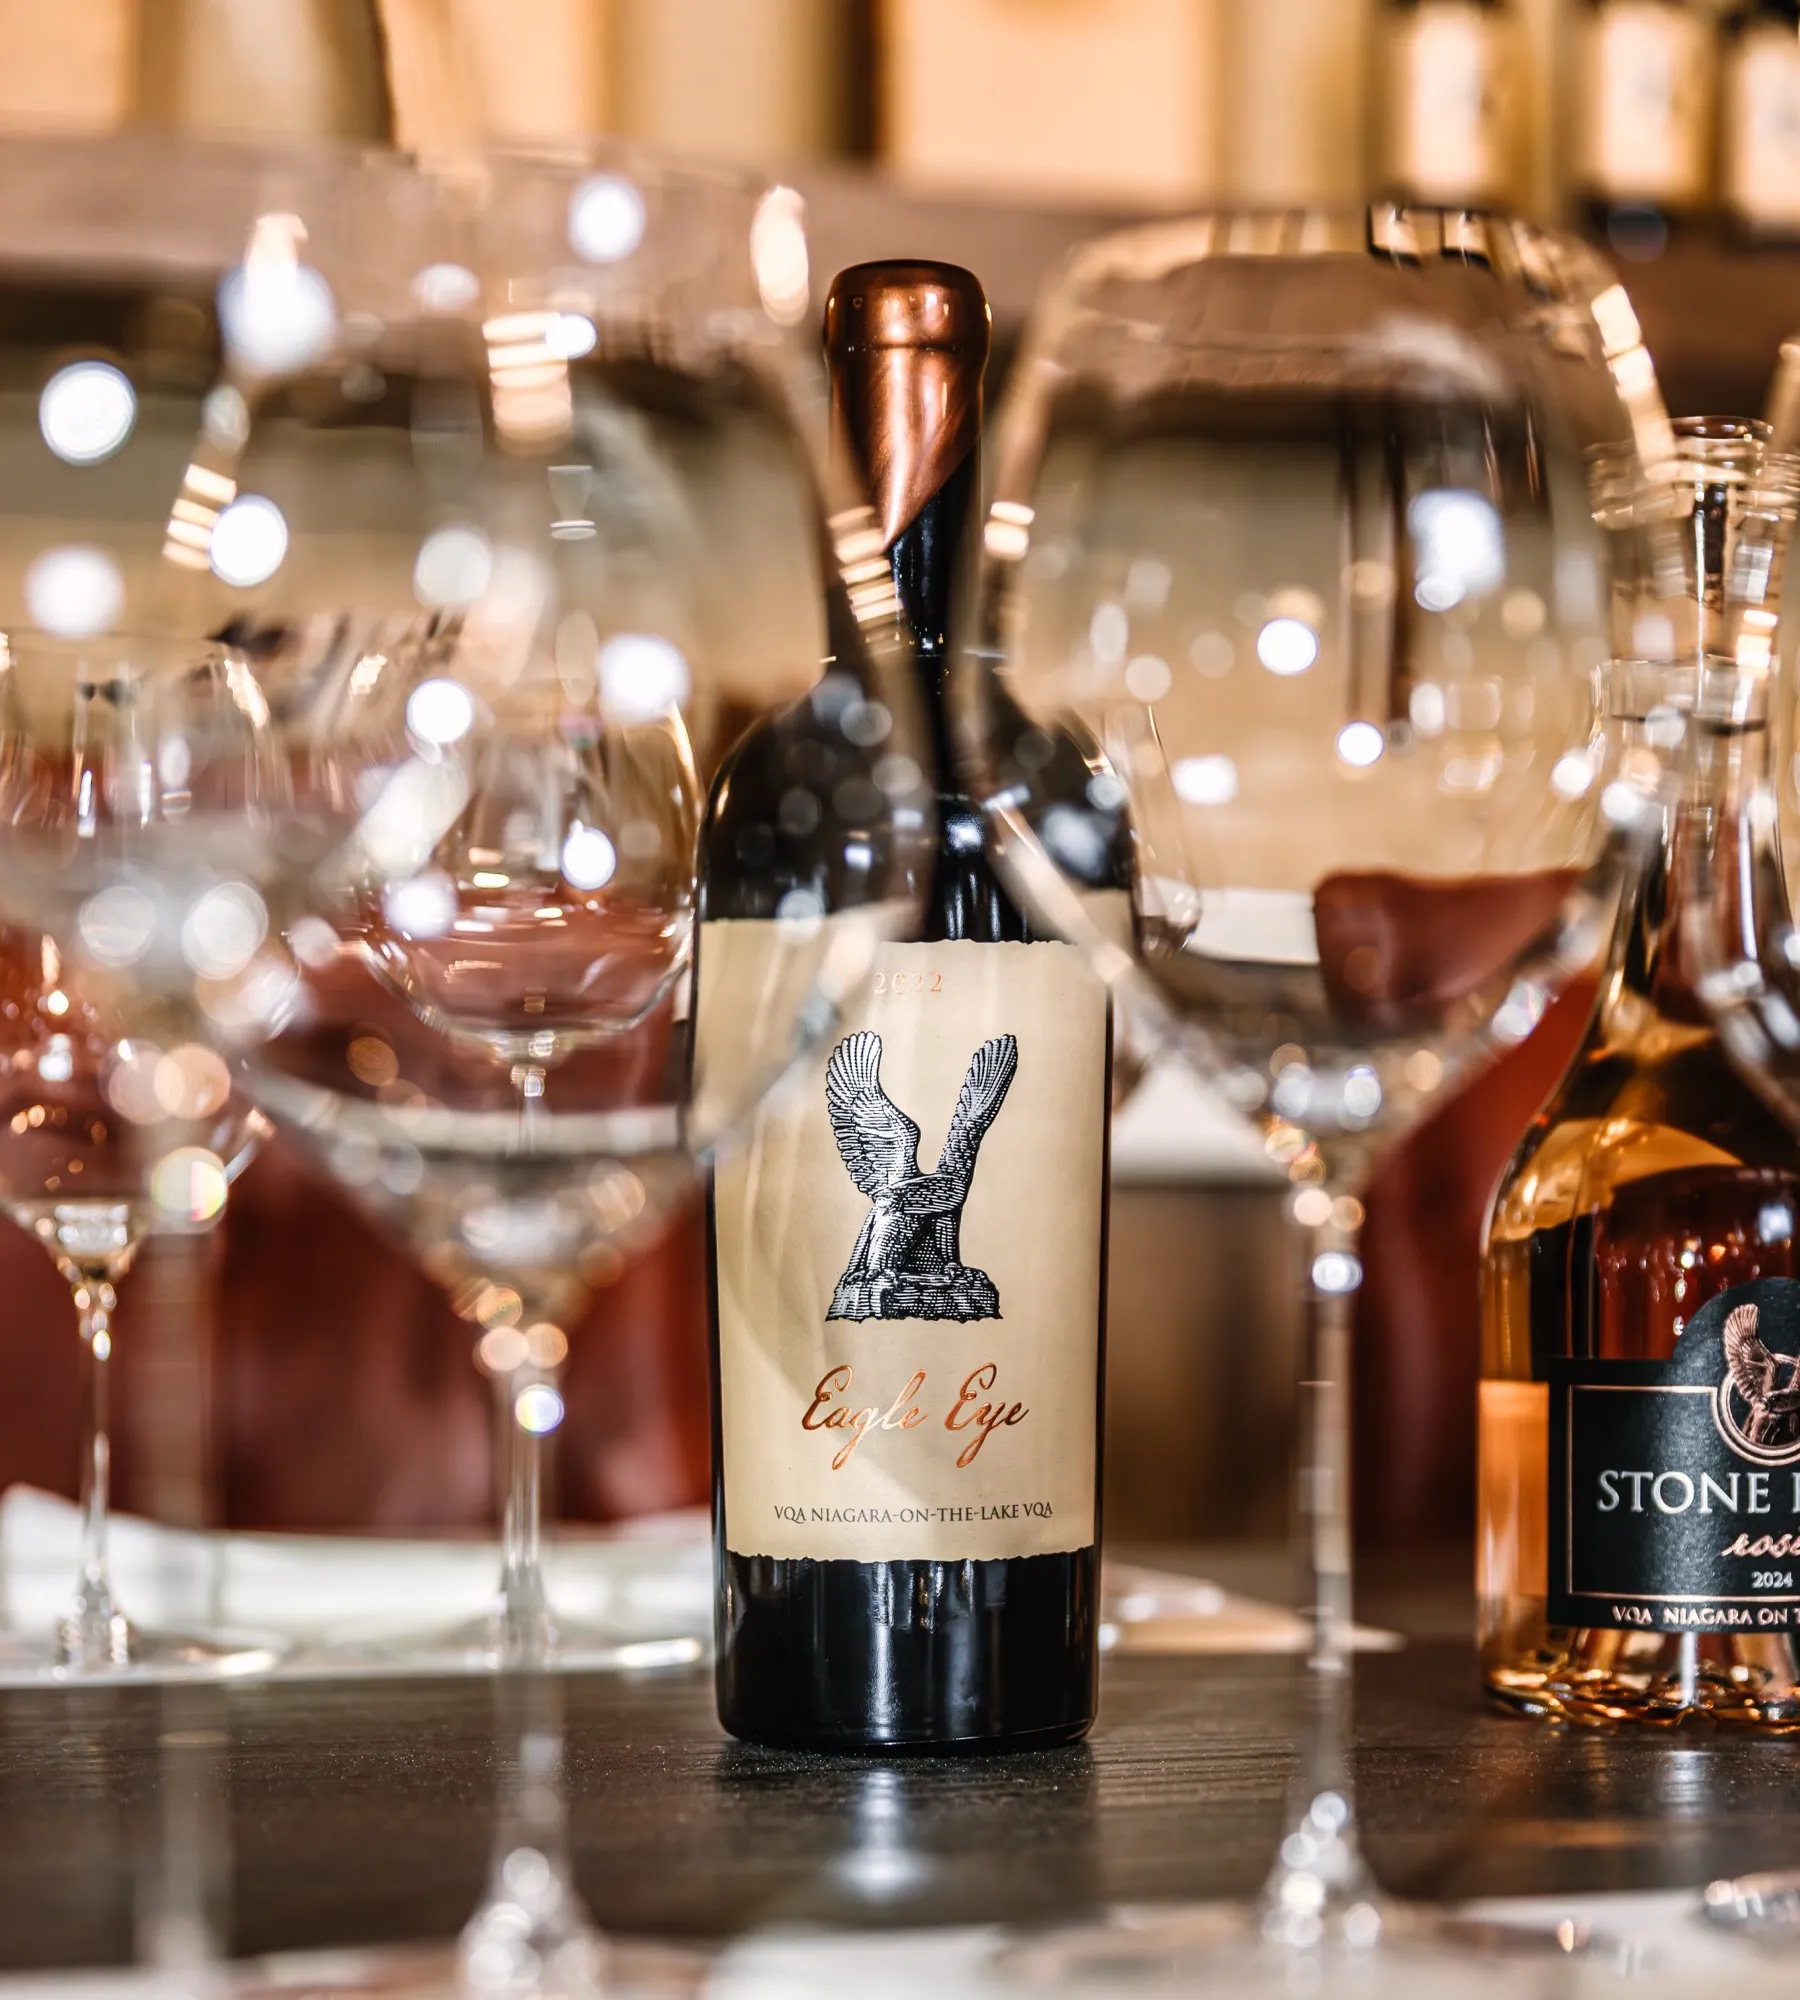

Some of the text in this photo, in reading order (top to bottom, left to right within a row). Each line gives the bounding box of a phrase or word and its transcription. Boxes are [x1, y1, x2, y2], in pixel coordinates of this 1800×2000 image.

[873, 971, 943, 994] 2022
[801, 1362, 1030, 1470] Eagle Eye
[1597, 1470, 1772, 1514] STONE
[773, 1501, 1054, 1524] VQA NIAGARA-ON-THE-LAKE VQA
[1751, 1571, 1794, 1588] 2024
[1612, 1606, 1653, 1625] VQA
[1663, 1607, 1753, 1625] NIAGARA
[1757, 1608, 1788, 1625] ON
